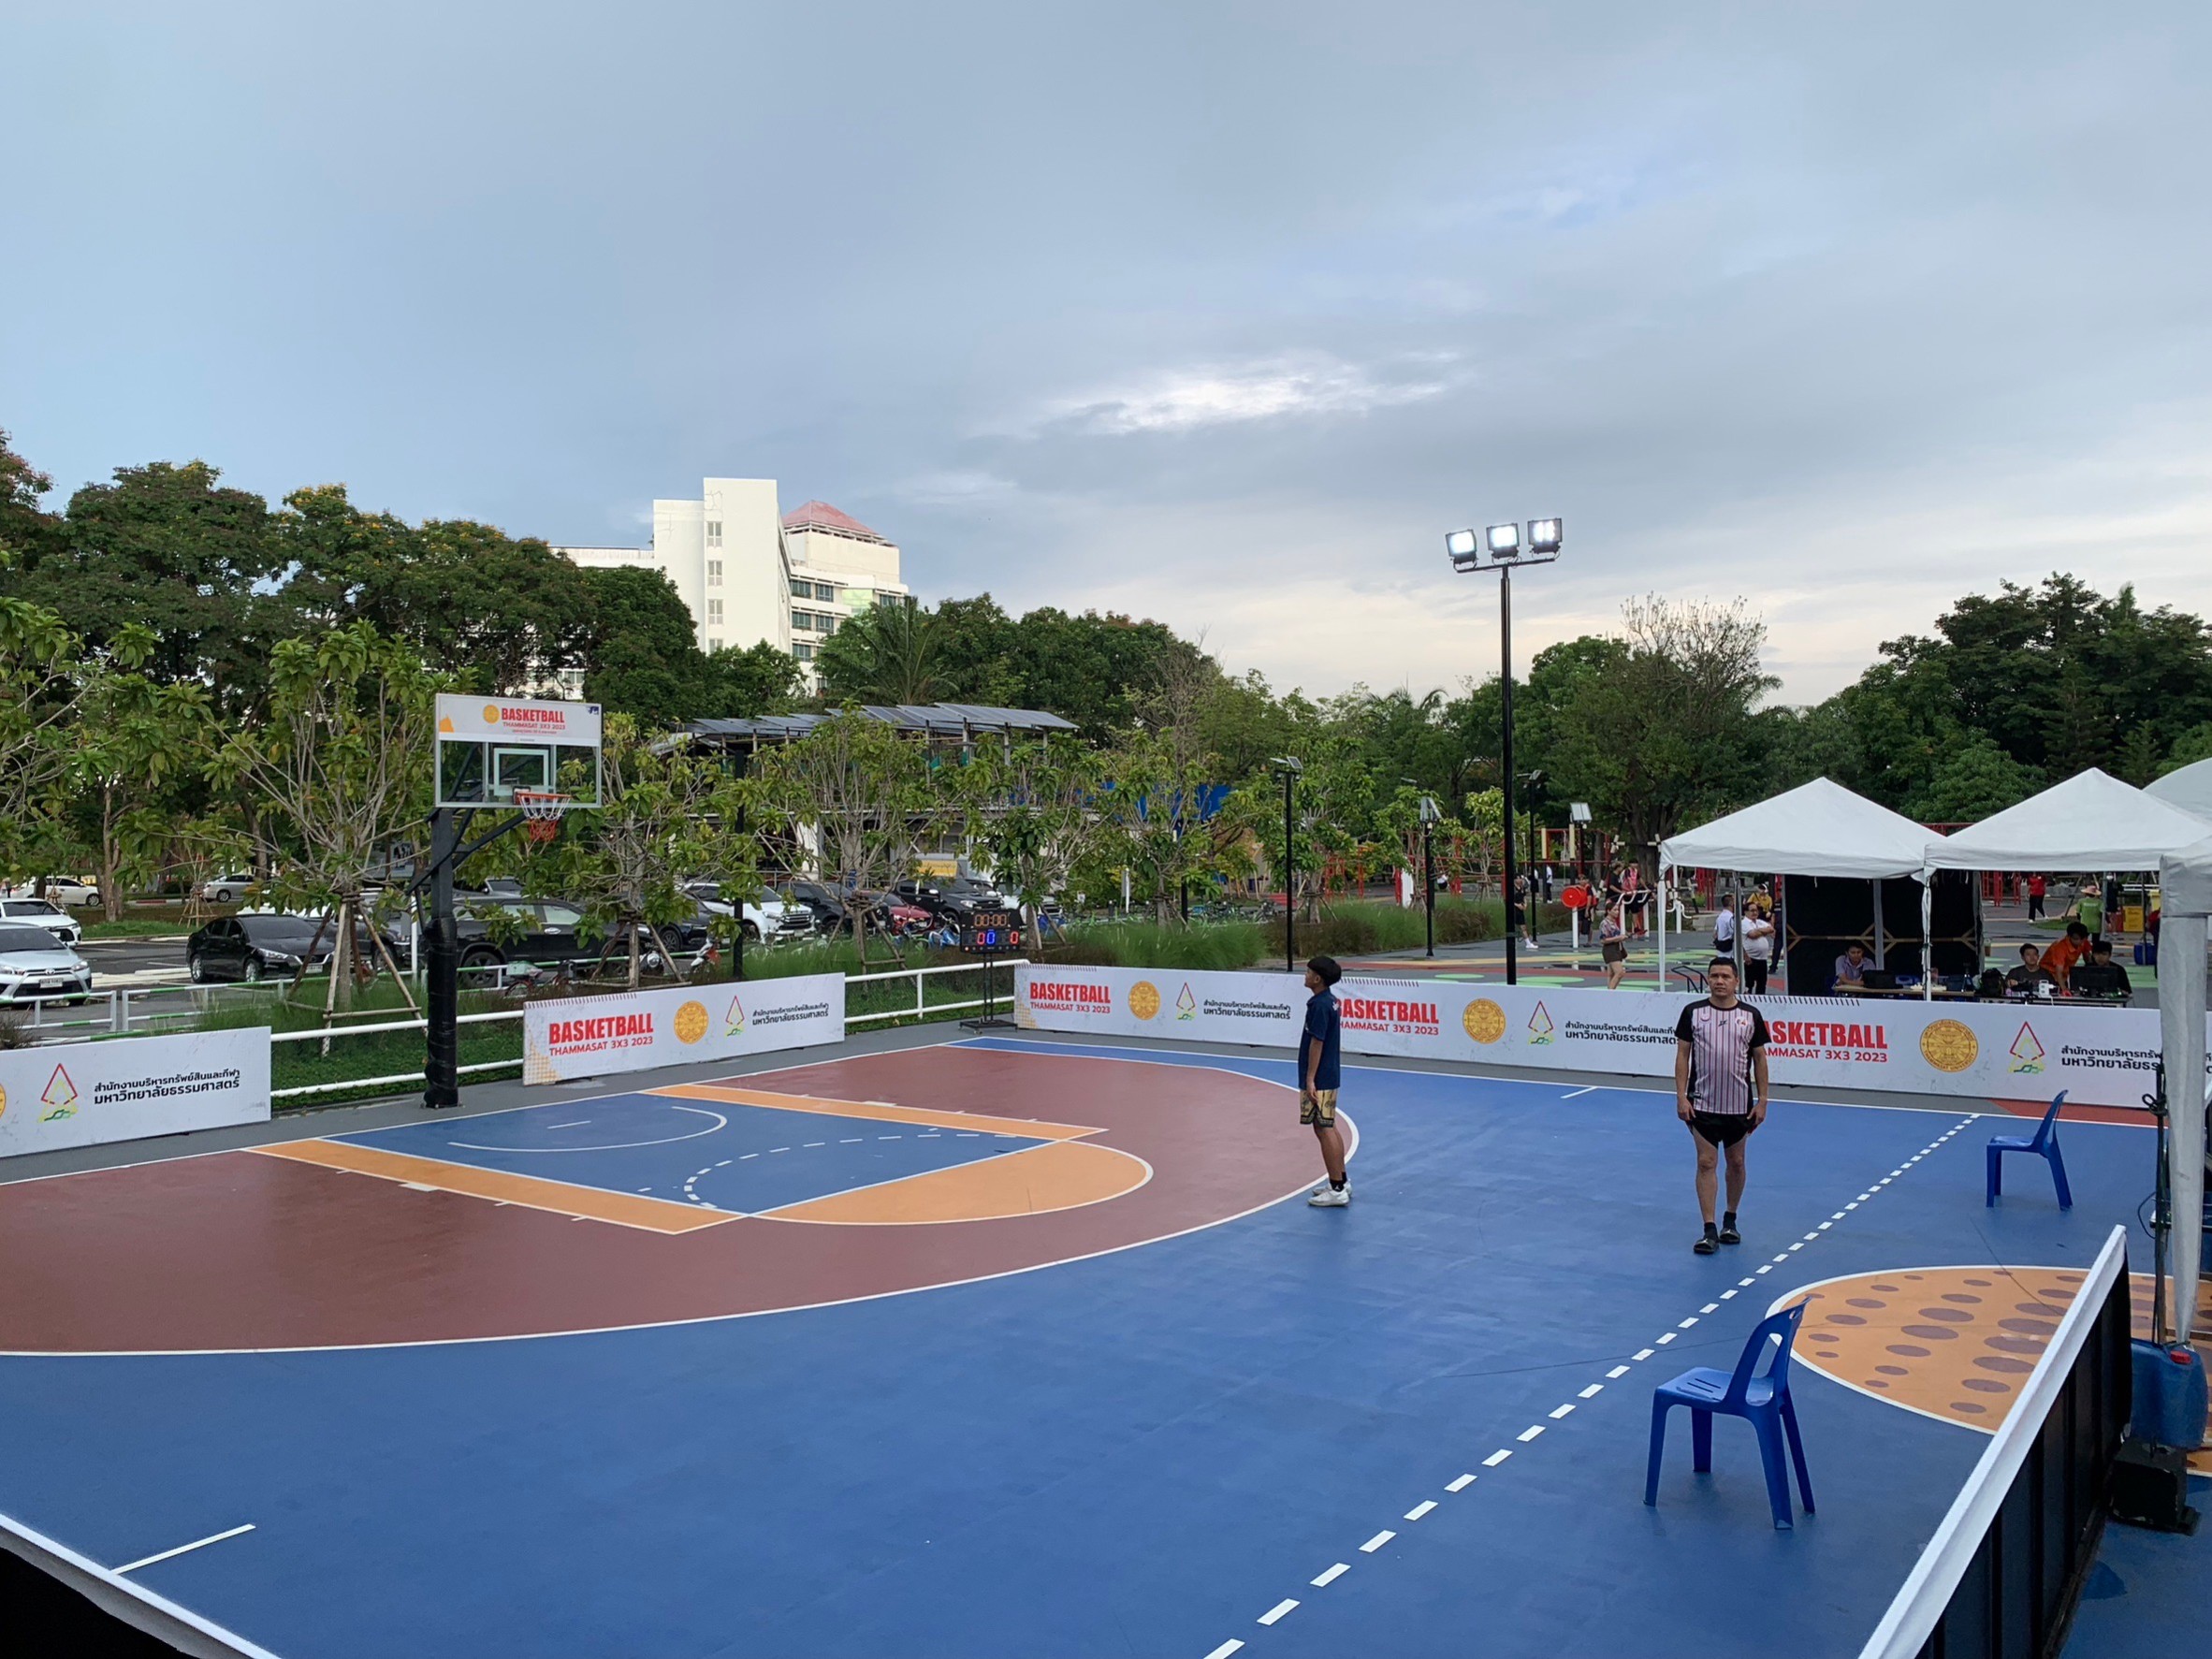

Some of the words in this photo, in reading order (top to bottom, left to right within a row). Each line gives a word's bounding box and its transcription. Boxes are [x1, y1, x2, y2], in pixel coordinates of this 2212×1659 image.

[502, 708, 564, 723] BASKETBALL
[974, 914, 1006, 926] 00:00
[1010, 931, 1019, 944] 0
[1030, 982, 1111, 1004] BASKETBALL
[1031, 1002, 1073, 1011] THAMMASAT
[1203, 1008, 1291, 1020] มหาวิทยาลัยธรรมศาสตร์
[752, 1011, 830, 1026] มหาวิทยาลัยธรรมศาสตร์
[549, 1013, 653, 1044] BASKETBALL
[1392, 1025, 1411, 1033] 3X3
[1415, 1026, 1439, 1035] 2023
[1565, 1020, 1676, 1035] สำนักงานบริหารทรัพย์สินและกี
[1565, 1029, 1679, 1045] มหาวิทยาลัยธรรมศาสต
[1765, 1021, 1888, 1050] SKETBALL
[549, 1041, 608, 1056] THAMMASAT
[611, 1040, 628, 1049] 3X3
[632, 1036, 654, 1046] 2023
[1766, 1047, 1821, 1059] MMASAT
[1825, 1050, 1850, 1060] 3X3
[1855, 1051, 1888, 1063] 2023
[95, 1069, 240, 1093] สำนักงานบริหารทรัพย์สินและกีฬา
[95, 1076, 240, 1105] มหาวิทยาลัยธรรมศาสตร์
